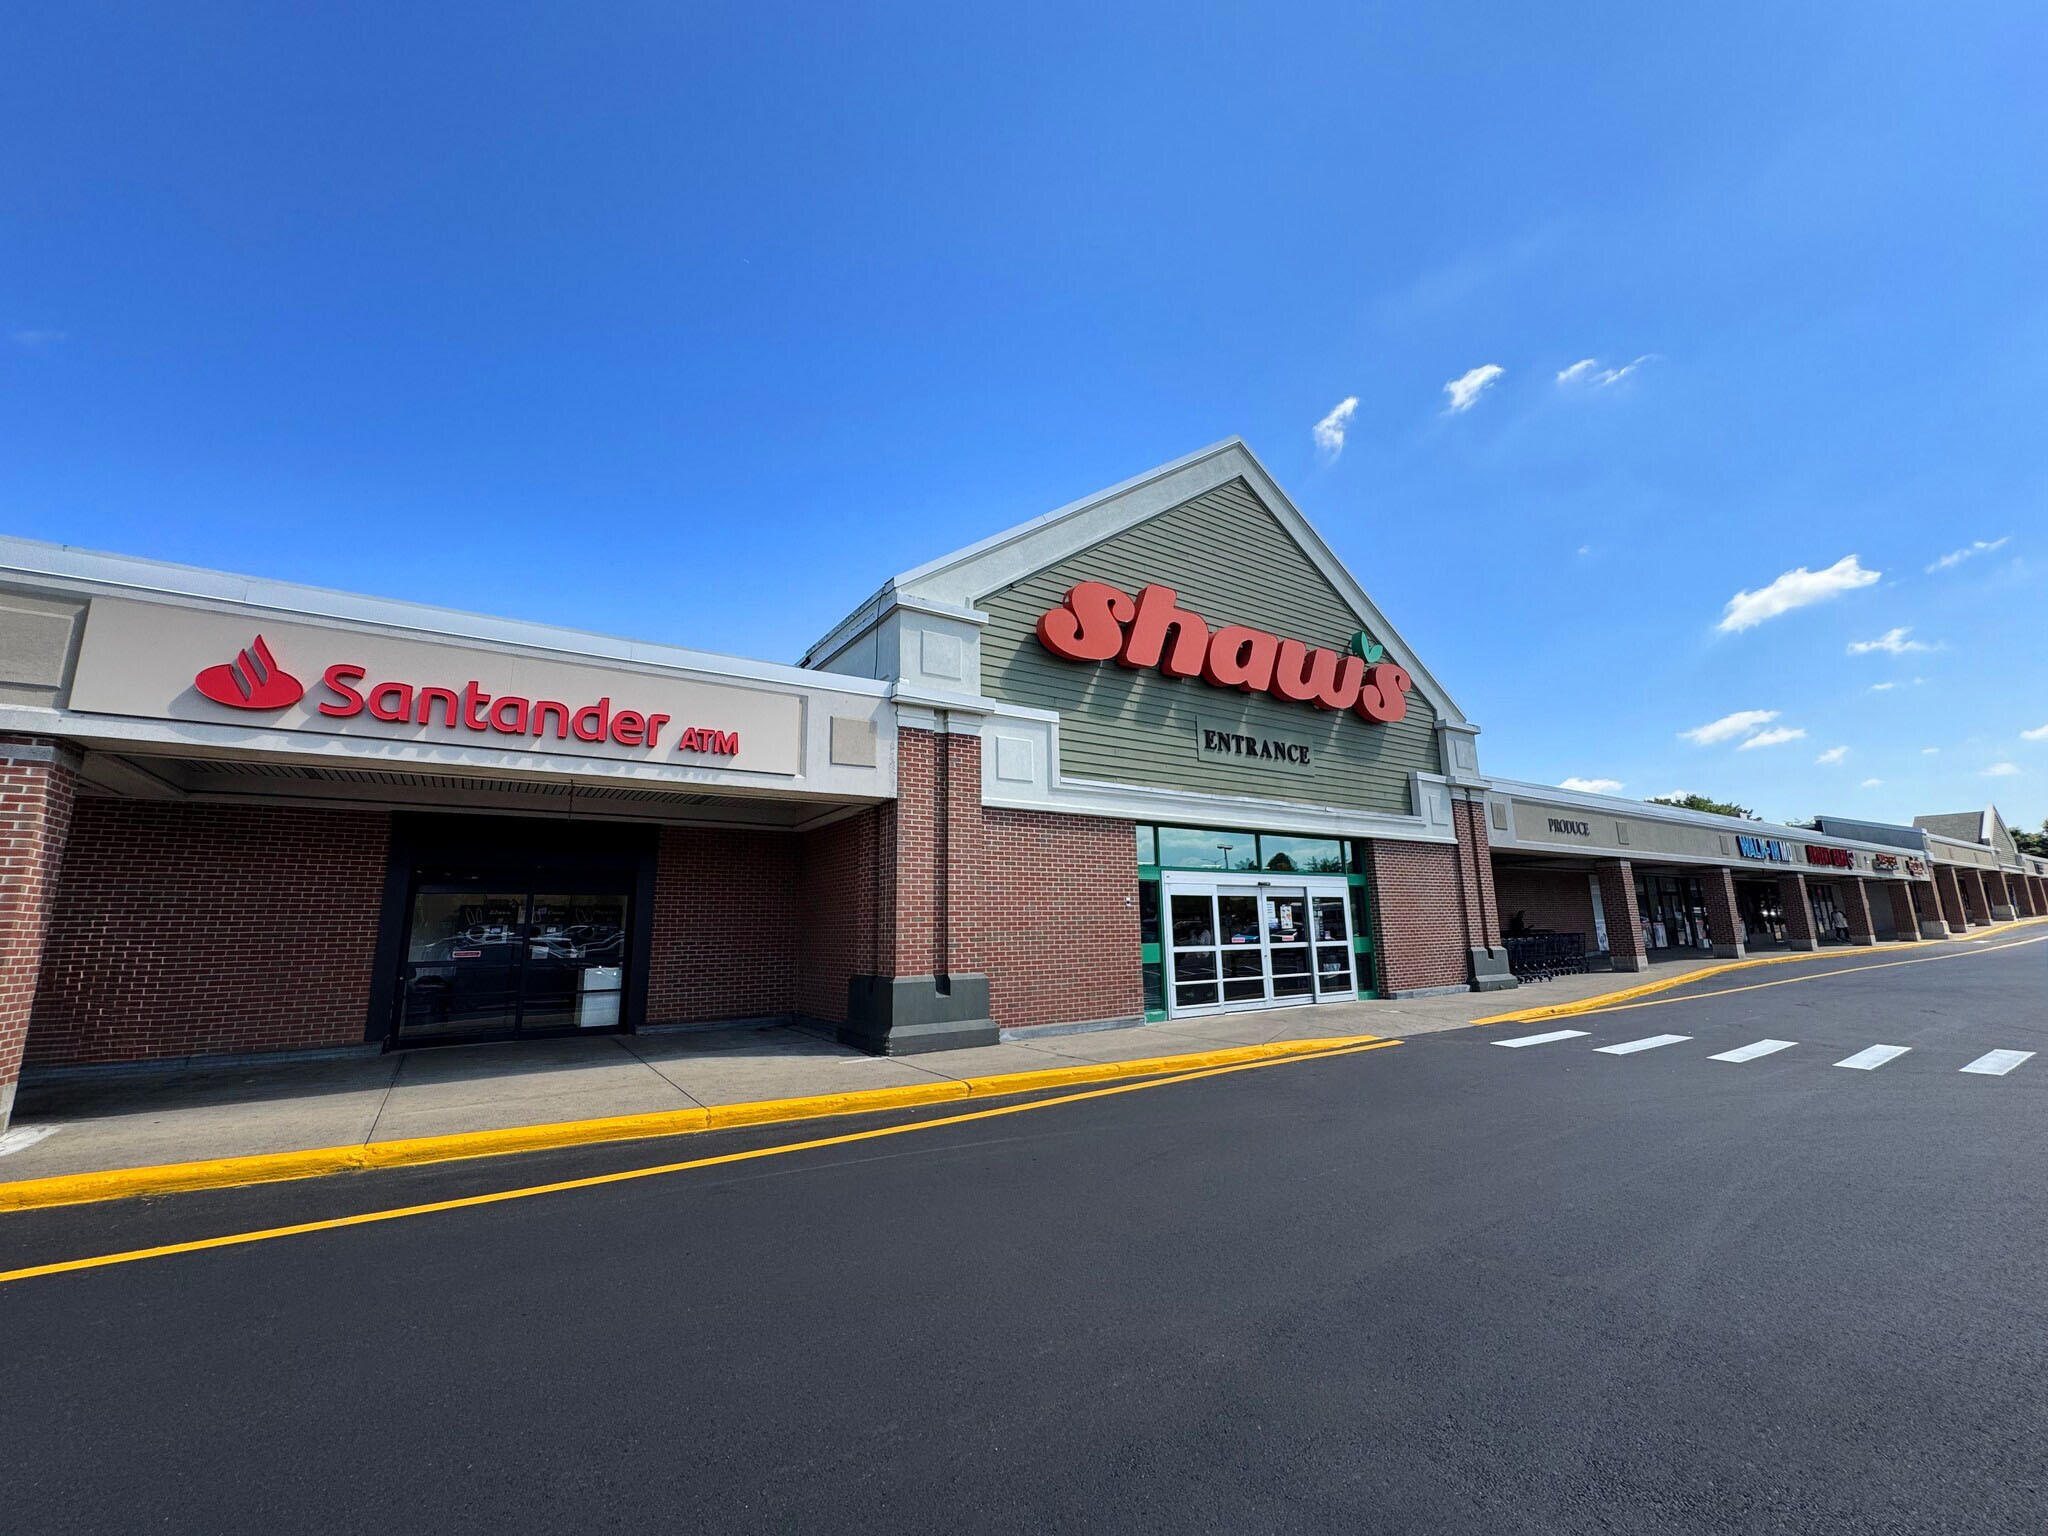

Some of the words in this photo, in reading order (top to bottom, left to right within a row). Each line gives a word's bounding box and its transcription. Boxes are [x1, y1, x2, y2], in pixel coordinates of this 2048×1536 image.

[318, 663, 670, 748] Santander
[679, 727, 739, 755] ATM
[1203, 729, 1310, 764] ENTRANCE
[1547, 818, 1590, 837] PRODUCE
[1736, 835, 1780, 861] WALK-IN
